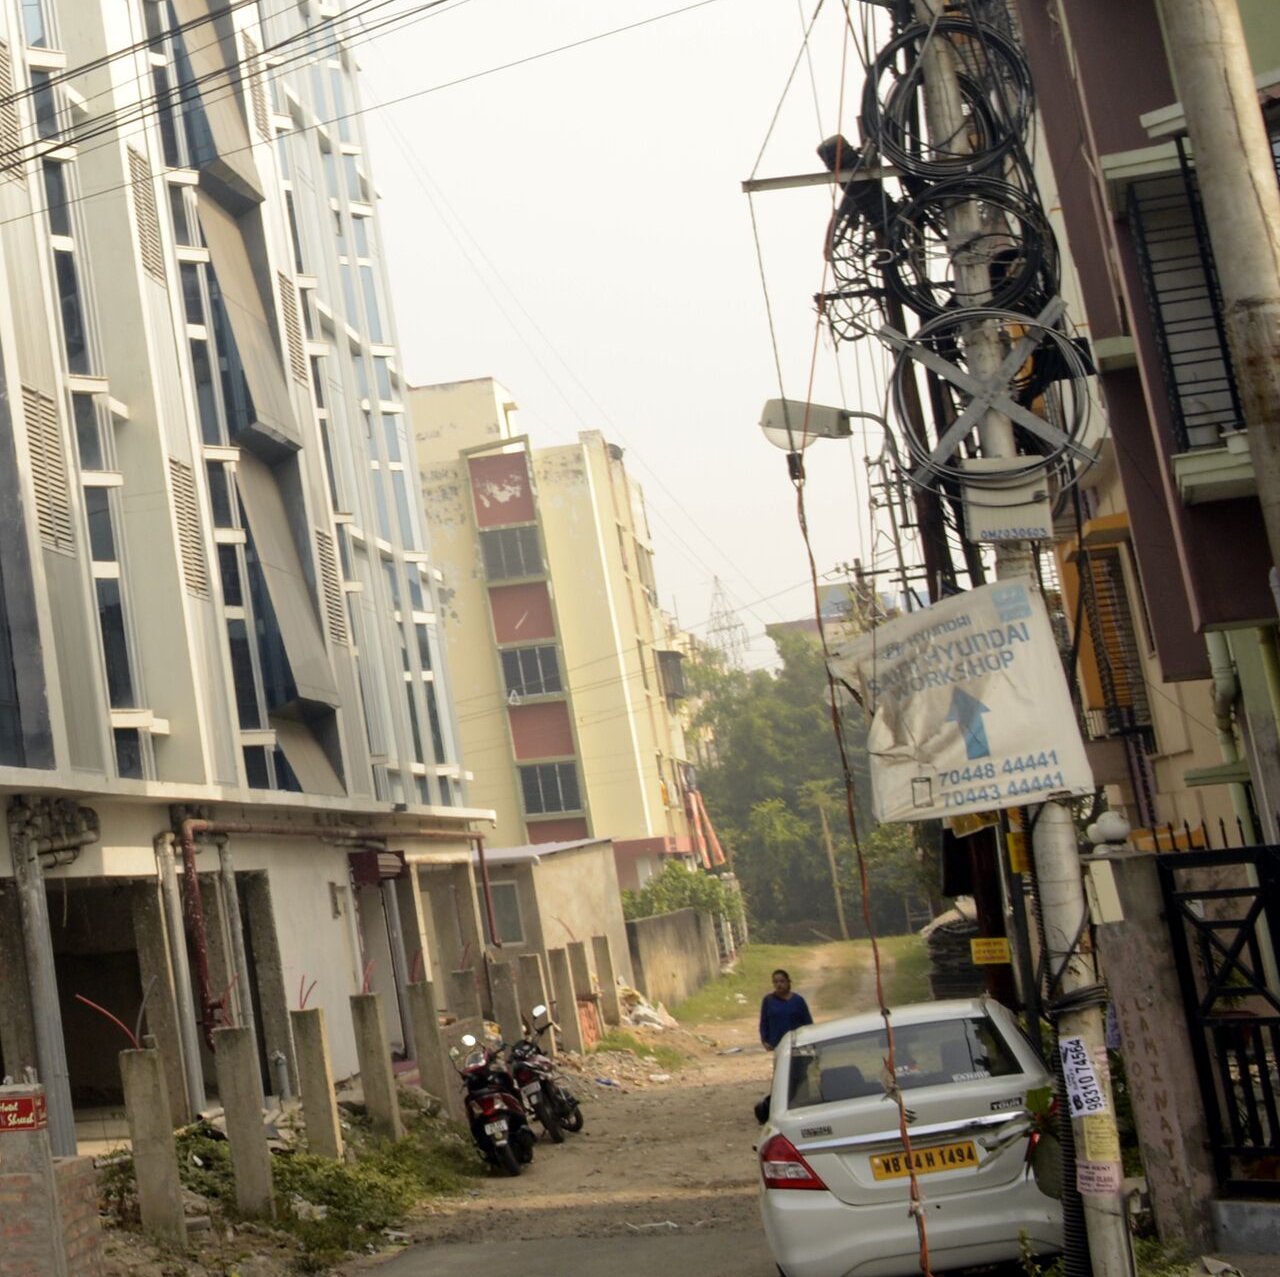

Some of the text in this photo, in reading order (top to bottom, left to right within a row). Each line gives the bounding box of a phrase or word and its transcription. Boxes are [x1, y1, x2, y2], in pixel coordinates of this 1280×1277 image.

[907, 614, 972, 646] HYUNDAI
[924, 622, 1030, 666] HYUNDAI
[890, 650, 1015, 701] WORKSHOP
[939, 749, 1059, 787] 70448 44441
[940, 771, 1065, 808] 70443 44441
[1067, 1039, 1090, 1074] 74564
[1118, 1001, 1145, 1103] XEROX
[1078, 1075, 1103, 1111] 98310
[881, 1156, 901, 1175] WB
[940, 1145, 975, 1166] 1494
